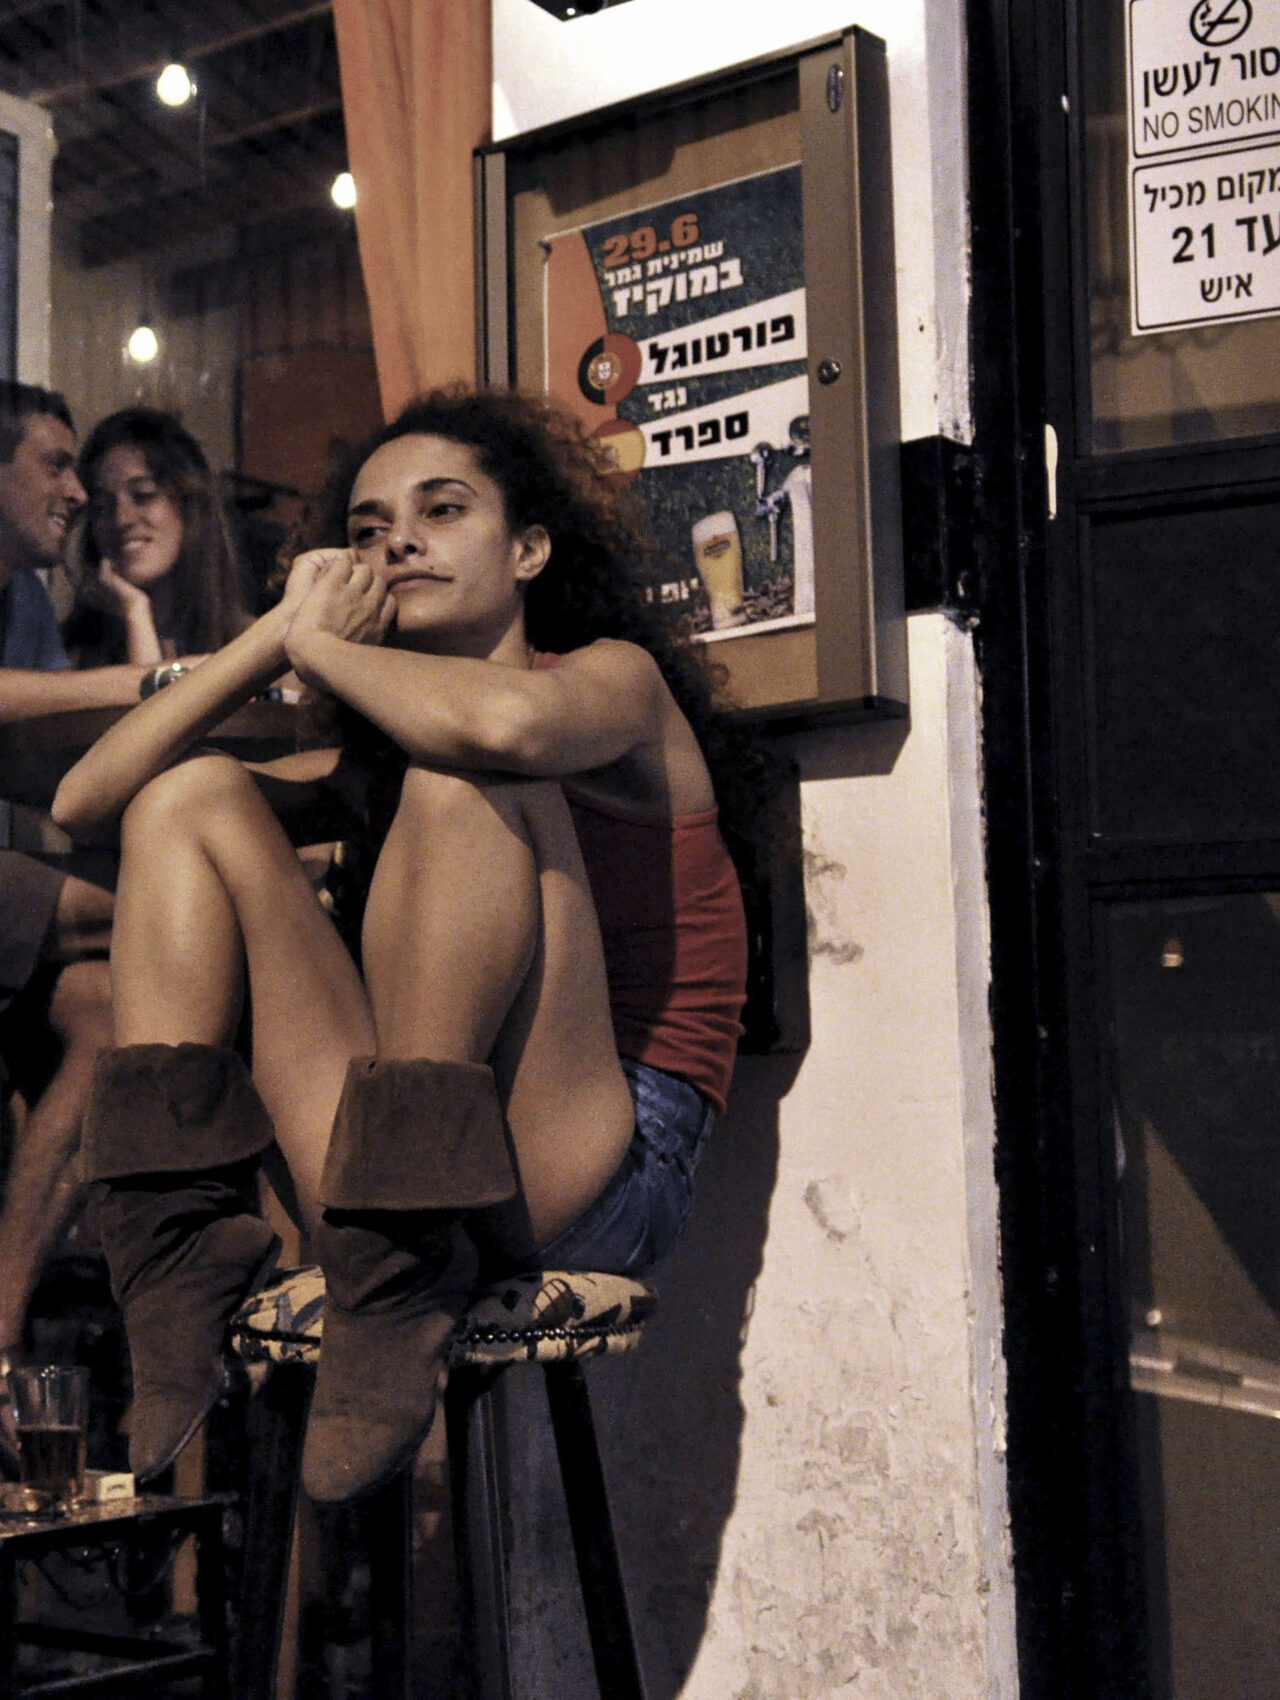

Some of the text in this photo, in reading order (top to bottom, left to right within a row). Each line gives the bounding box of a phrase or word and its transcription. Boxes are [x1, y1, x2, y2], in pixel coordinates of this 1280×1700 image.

[1143, 51, 1221, 108] לעשן
[1143, 111, 1179, 142] NO
[1144, 180, 1206, 212] מכיל
[604, 213, 700, 269] 29.6
[1172, 212, 1280, 264] עד 21
[604, 240, 724, 287] שמינית גמר
[613, 257, 745, 318] במוקיז
[1201, 273, 1252, 303] איש
[649, 314, 795, 375] פורטוגל
[648, 386, 687, 411] נגד
[652, 411, 749, 456] ספרד
